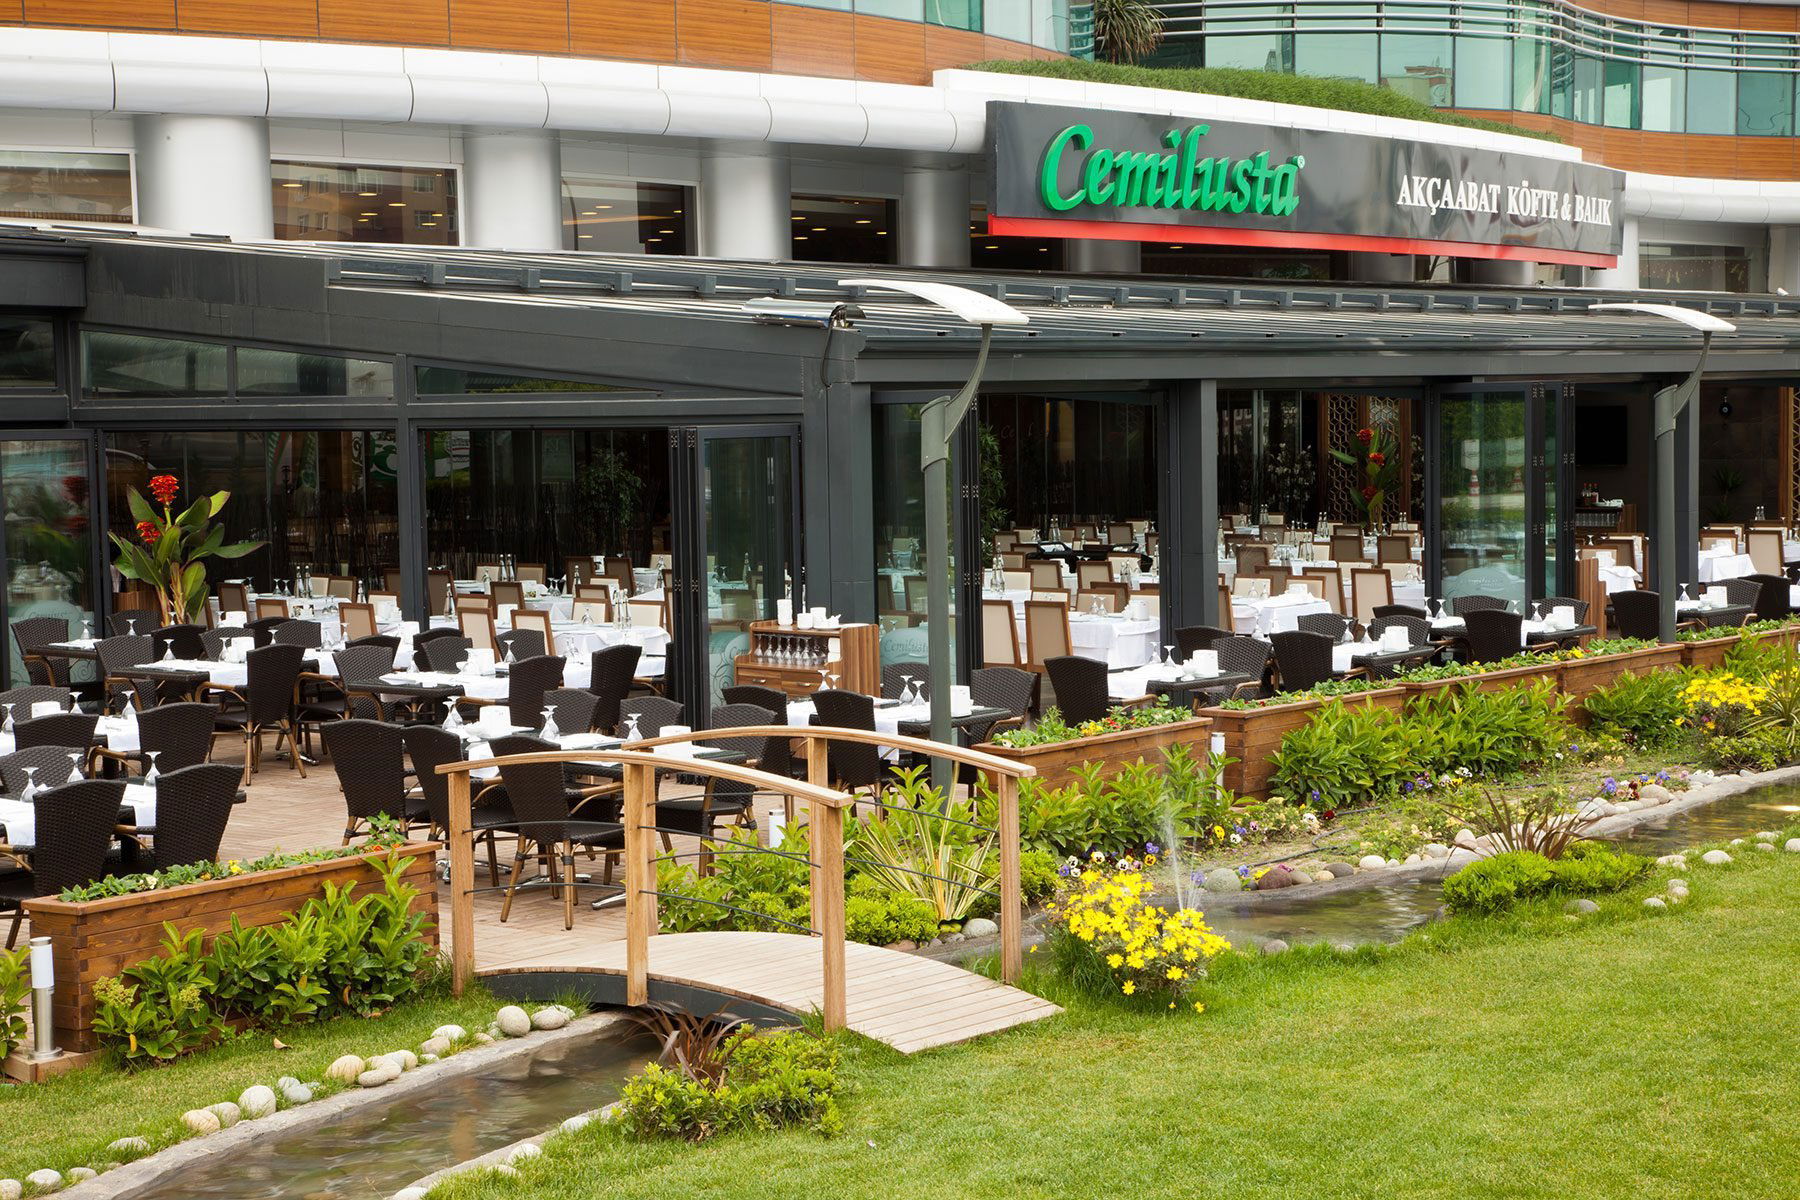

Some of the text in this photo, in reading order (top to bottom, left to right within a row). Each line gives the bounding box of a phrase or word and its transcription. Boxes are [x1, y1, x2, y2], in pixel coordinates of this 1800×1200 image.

[1396, 174, 1613, 226] AKÇAABAT KÖFTE & BALIK
